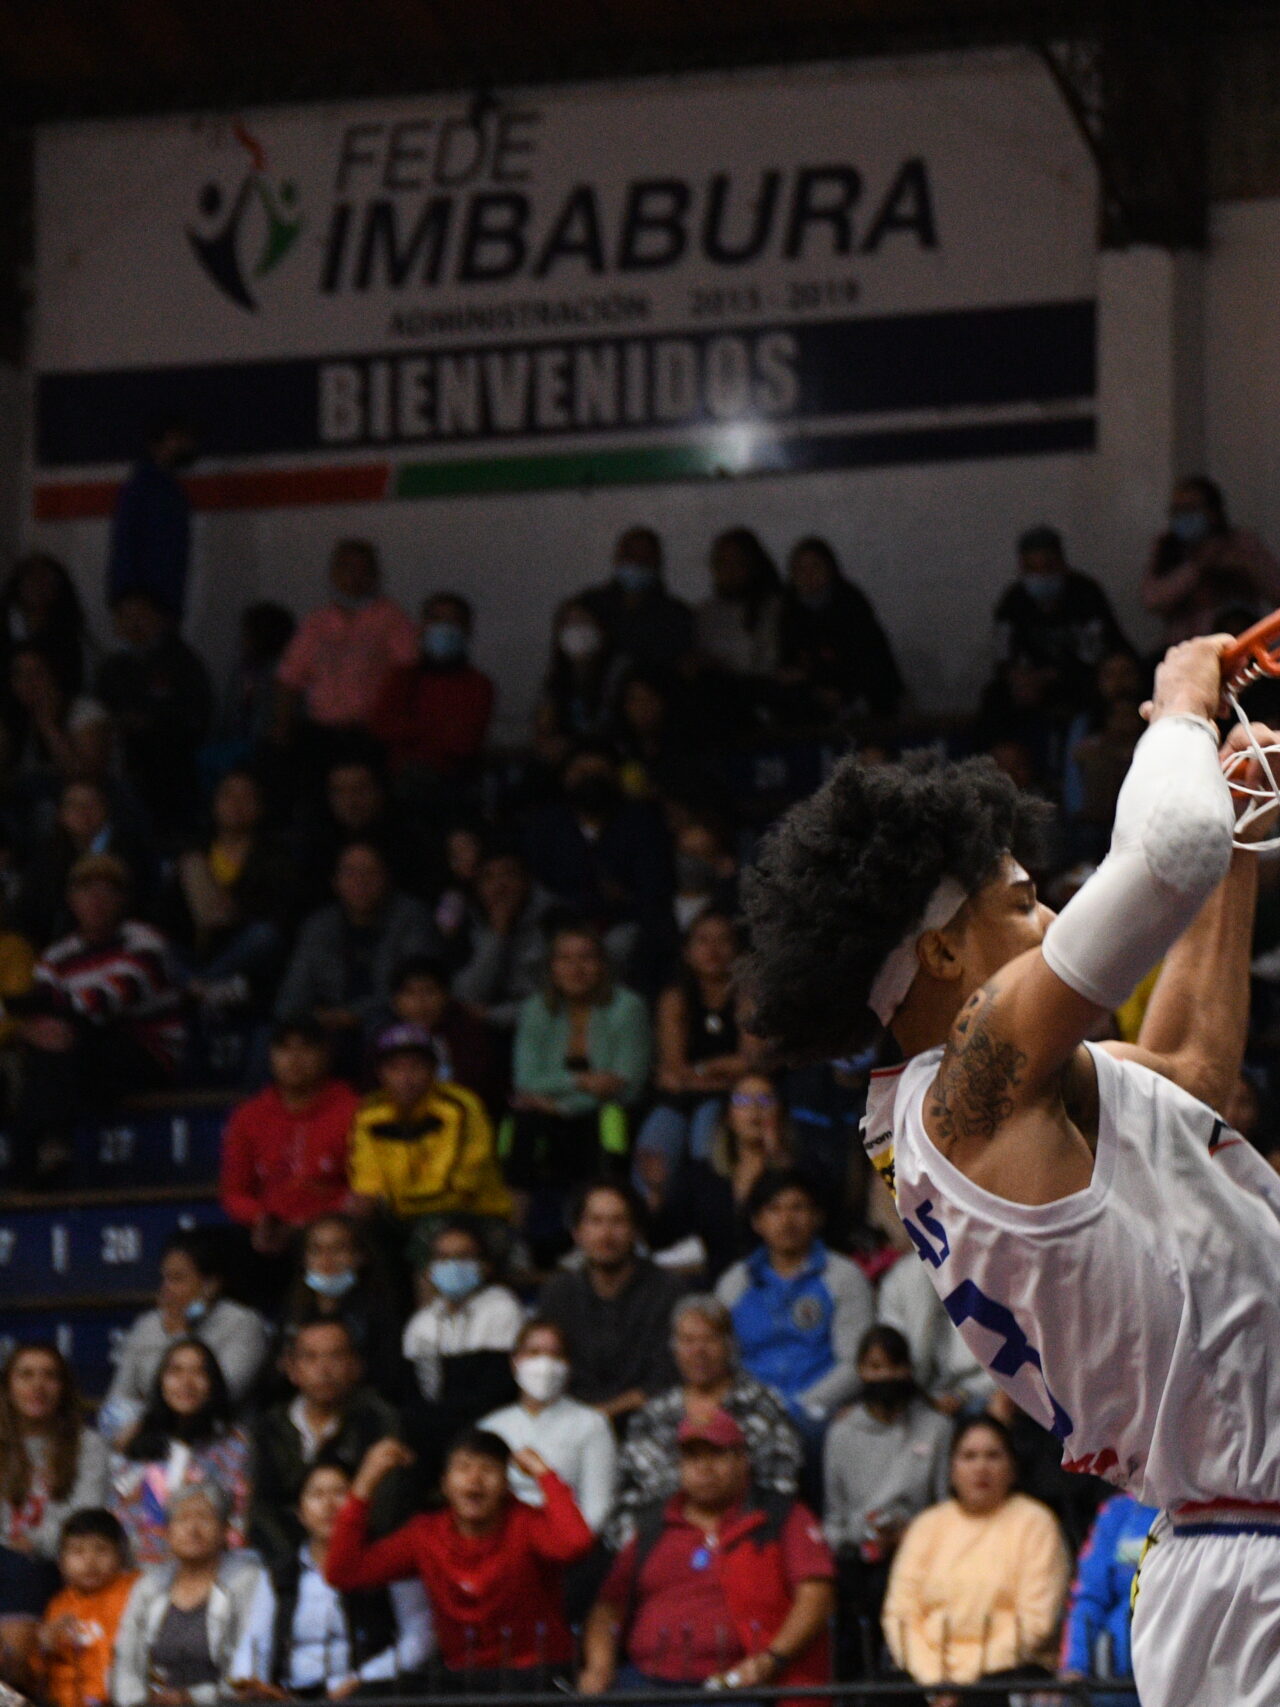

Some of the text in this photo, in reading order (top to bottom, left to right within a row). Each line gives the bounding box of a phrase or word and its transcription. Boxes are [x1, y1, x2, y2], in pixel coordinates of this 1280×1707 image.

[335, 109, 542, 193] FEDE
[319, 156, 940, 294] IMBABURA
[317, 331, 801, 444] BIENVENIDOS
